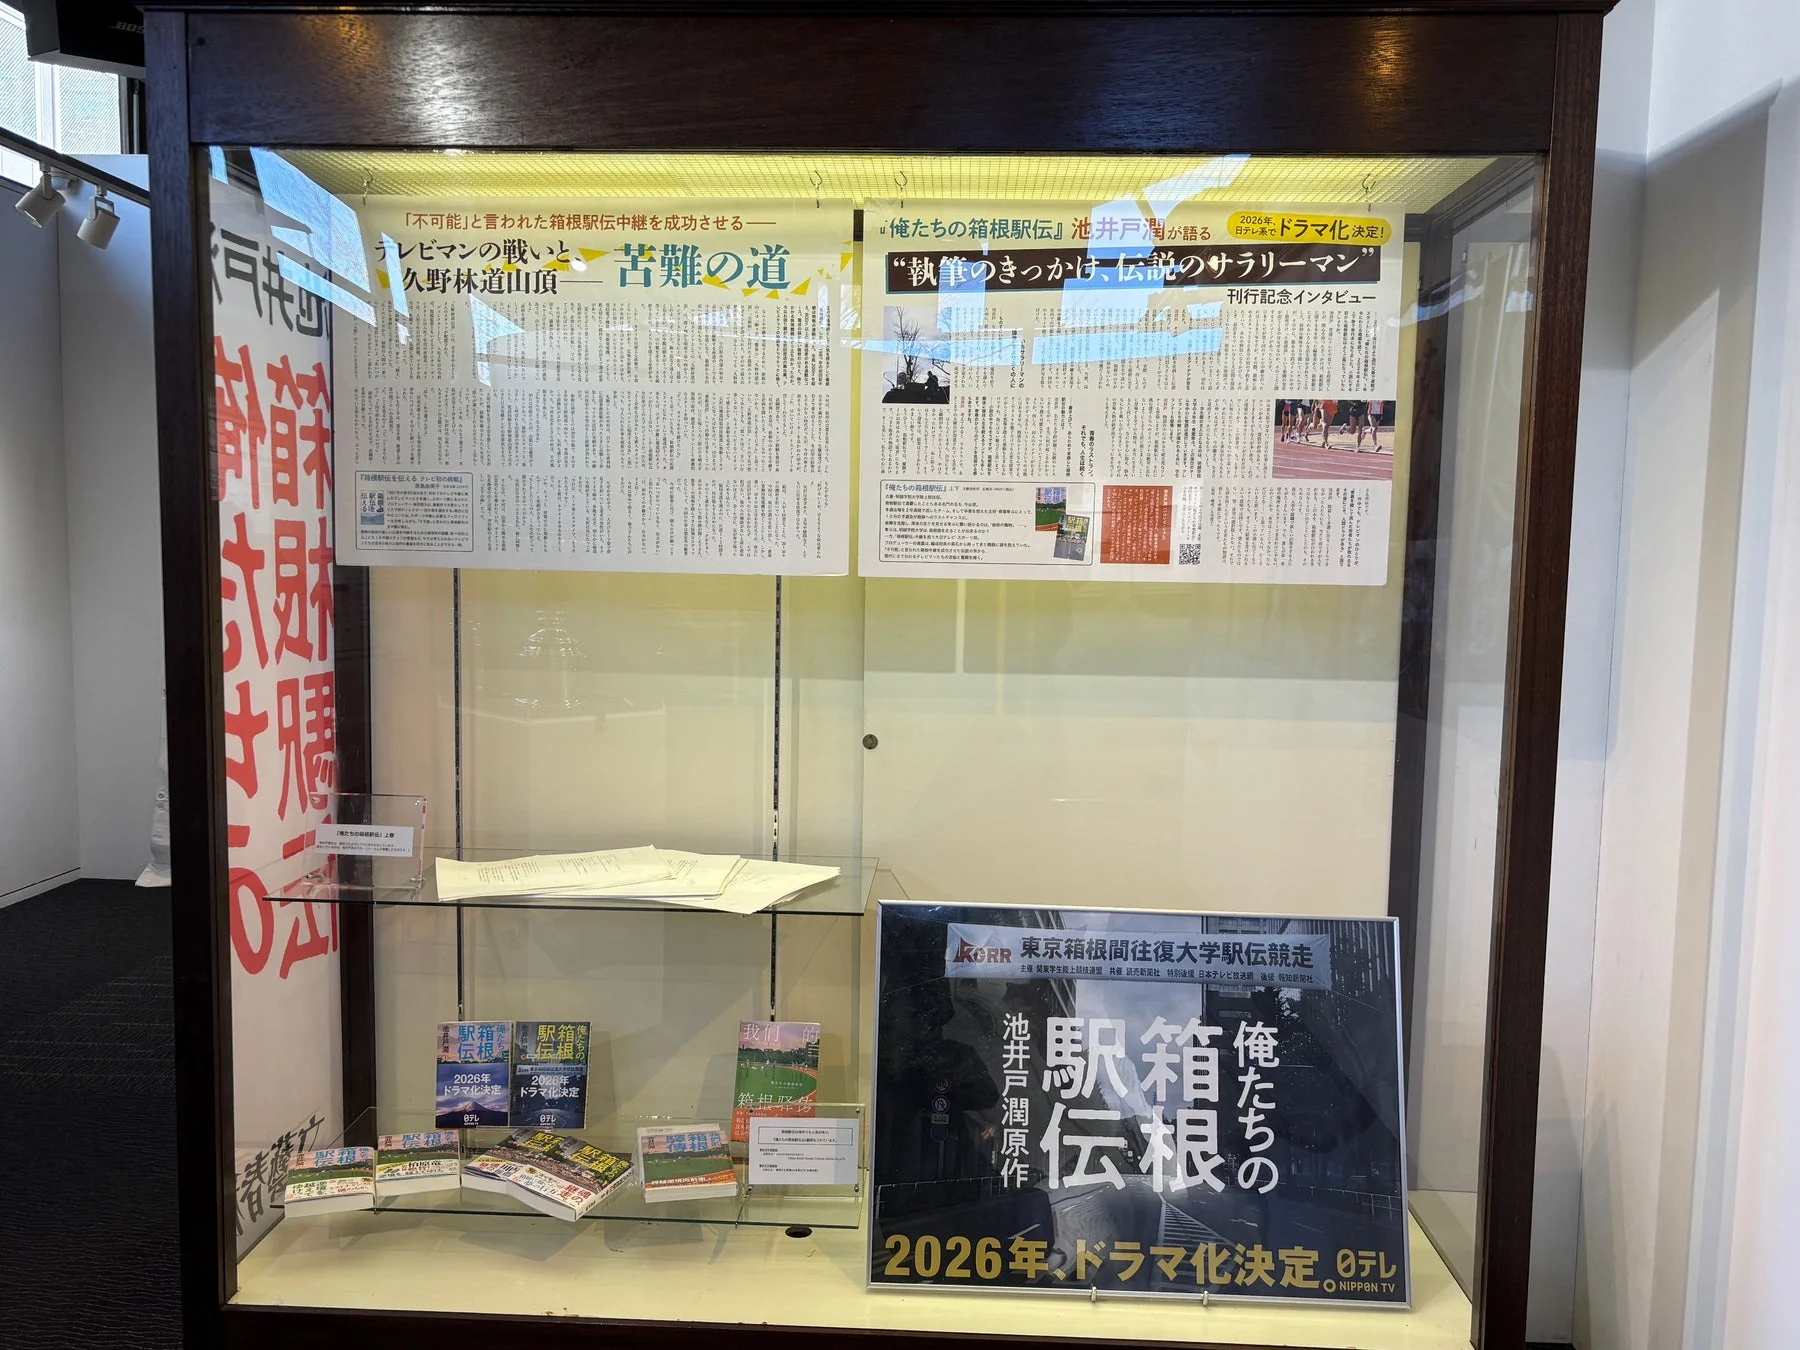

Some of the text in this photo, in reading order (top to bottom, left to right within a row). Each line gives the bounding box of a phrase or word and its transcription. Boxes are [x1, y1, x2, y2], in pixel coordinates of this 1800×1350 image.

[1235, 226, 1277, 237] 日テレ系で
[613, 243, 791, 290] 苦難の道
[1226, 288, 1377, 305] 刊行記念インタビュー
[1020, 935, 1314, 969] 東京箱根間往復大学駅伝競走
[1020, 964, 1033, 973] 主催
[1109, 967, 1123, 976] 共催
[1126, 967, 1160, 977] 読売新聞社
[1199, 970, 1254, 981] 日本テレビ放送網
[458, 1024, 475, 1060] 駅伝
[477, 1024, 494, 1060] 箱根
[536, 1024, 556, 1060] 駅伝
[556, 1024, 576, 1060] 箱根
[444, 1084, 502, 1097] ドラマ化決定
[454, 1073, 491, 1084] 2026年
[520, 1086, 580, 1098] ドラマ化決定
[531, 1075, 570, 1086] 2026年
[1000, 1012, 1031, 1188] 池井戸潤原作
[1040, 1017, 1128, 1191] 駅伝
[1139, 1016, 1226, 1193] 箱根
[1233, 1020, 1280, 1194] 俺たちの
[463, 1114, 480, 1122] 日テレ
[540, 1114, 557, 1122] 日テレ
[883, 1234, 1337, 1293] 2026年、ドラマ化決定。
[1336, 1248, 1397, 1279] 日テレ
[1339, 1281, 1396, 1293] NIPPON TV
